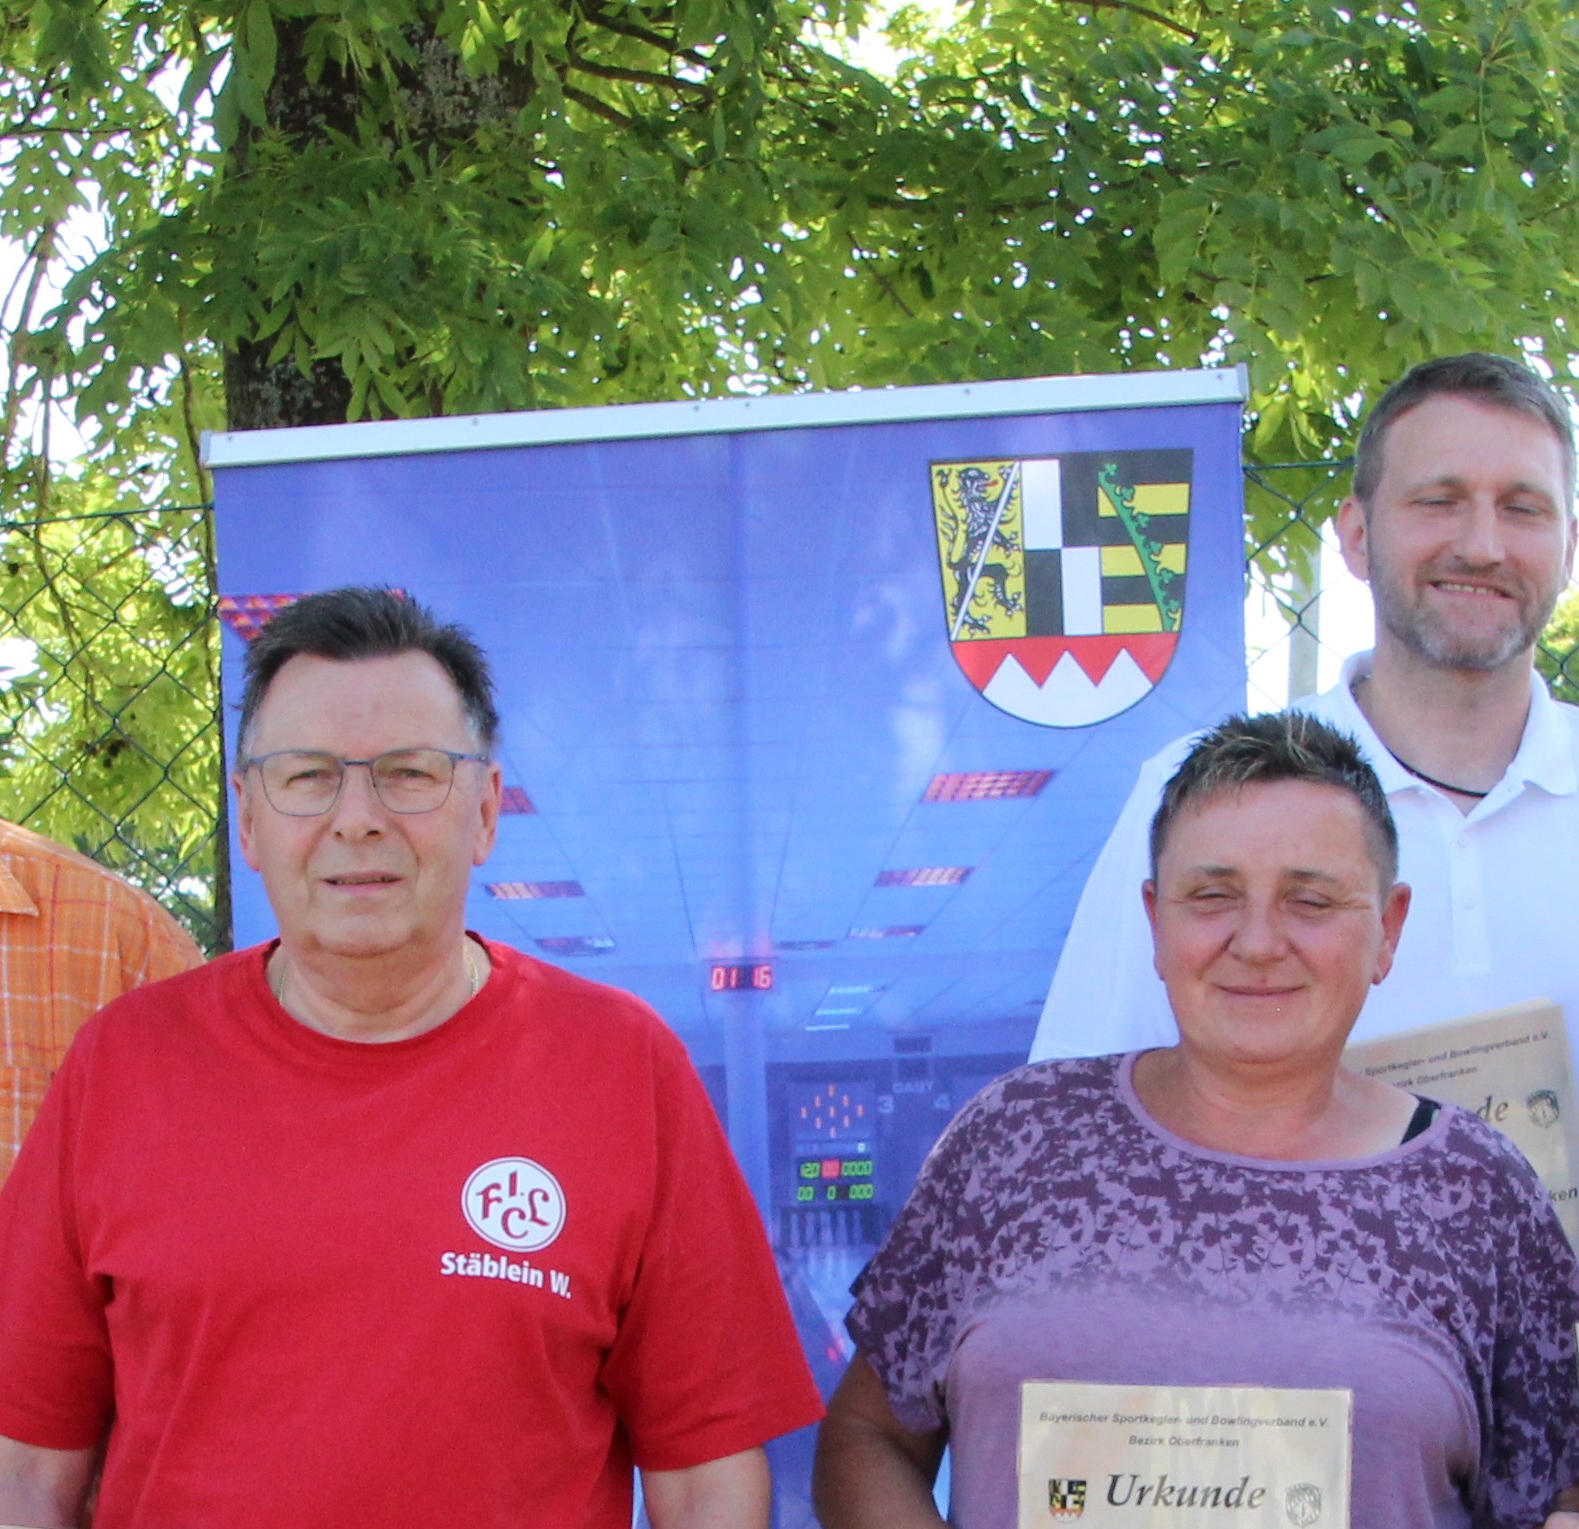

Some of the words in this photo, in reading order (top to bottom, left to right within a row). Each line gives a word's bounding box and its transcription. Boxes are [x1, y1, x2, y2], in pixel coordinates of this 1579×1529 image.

[710, 966, 739, 991] 01
[1428, 1053, 1447, 1063] und
[1416, 1066, 1478, 1084] Oberfranken
[440, 1252, 544, 1288] Stäblein
[550, 1270, 571, 1299] W.
[1039, 1411, 1108, 1425] Bayerischer
[1186, 1416, 1208, 1426] und
[1212, 1416, 1305, 1429] Bowlingverband
[1308, 1418, 1329, 1427] e.V.
[1128, 1435, 1164, 1446] Bezirk
[1168, 1436, 1239, 1447] Oberfranken
[1106, 1473, 1266, 1509] Urkunde
